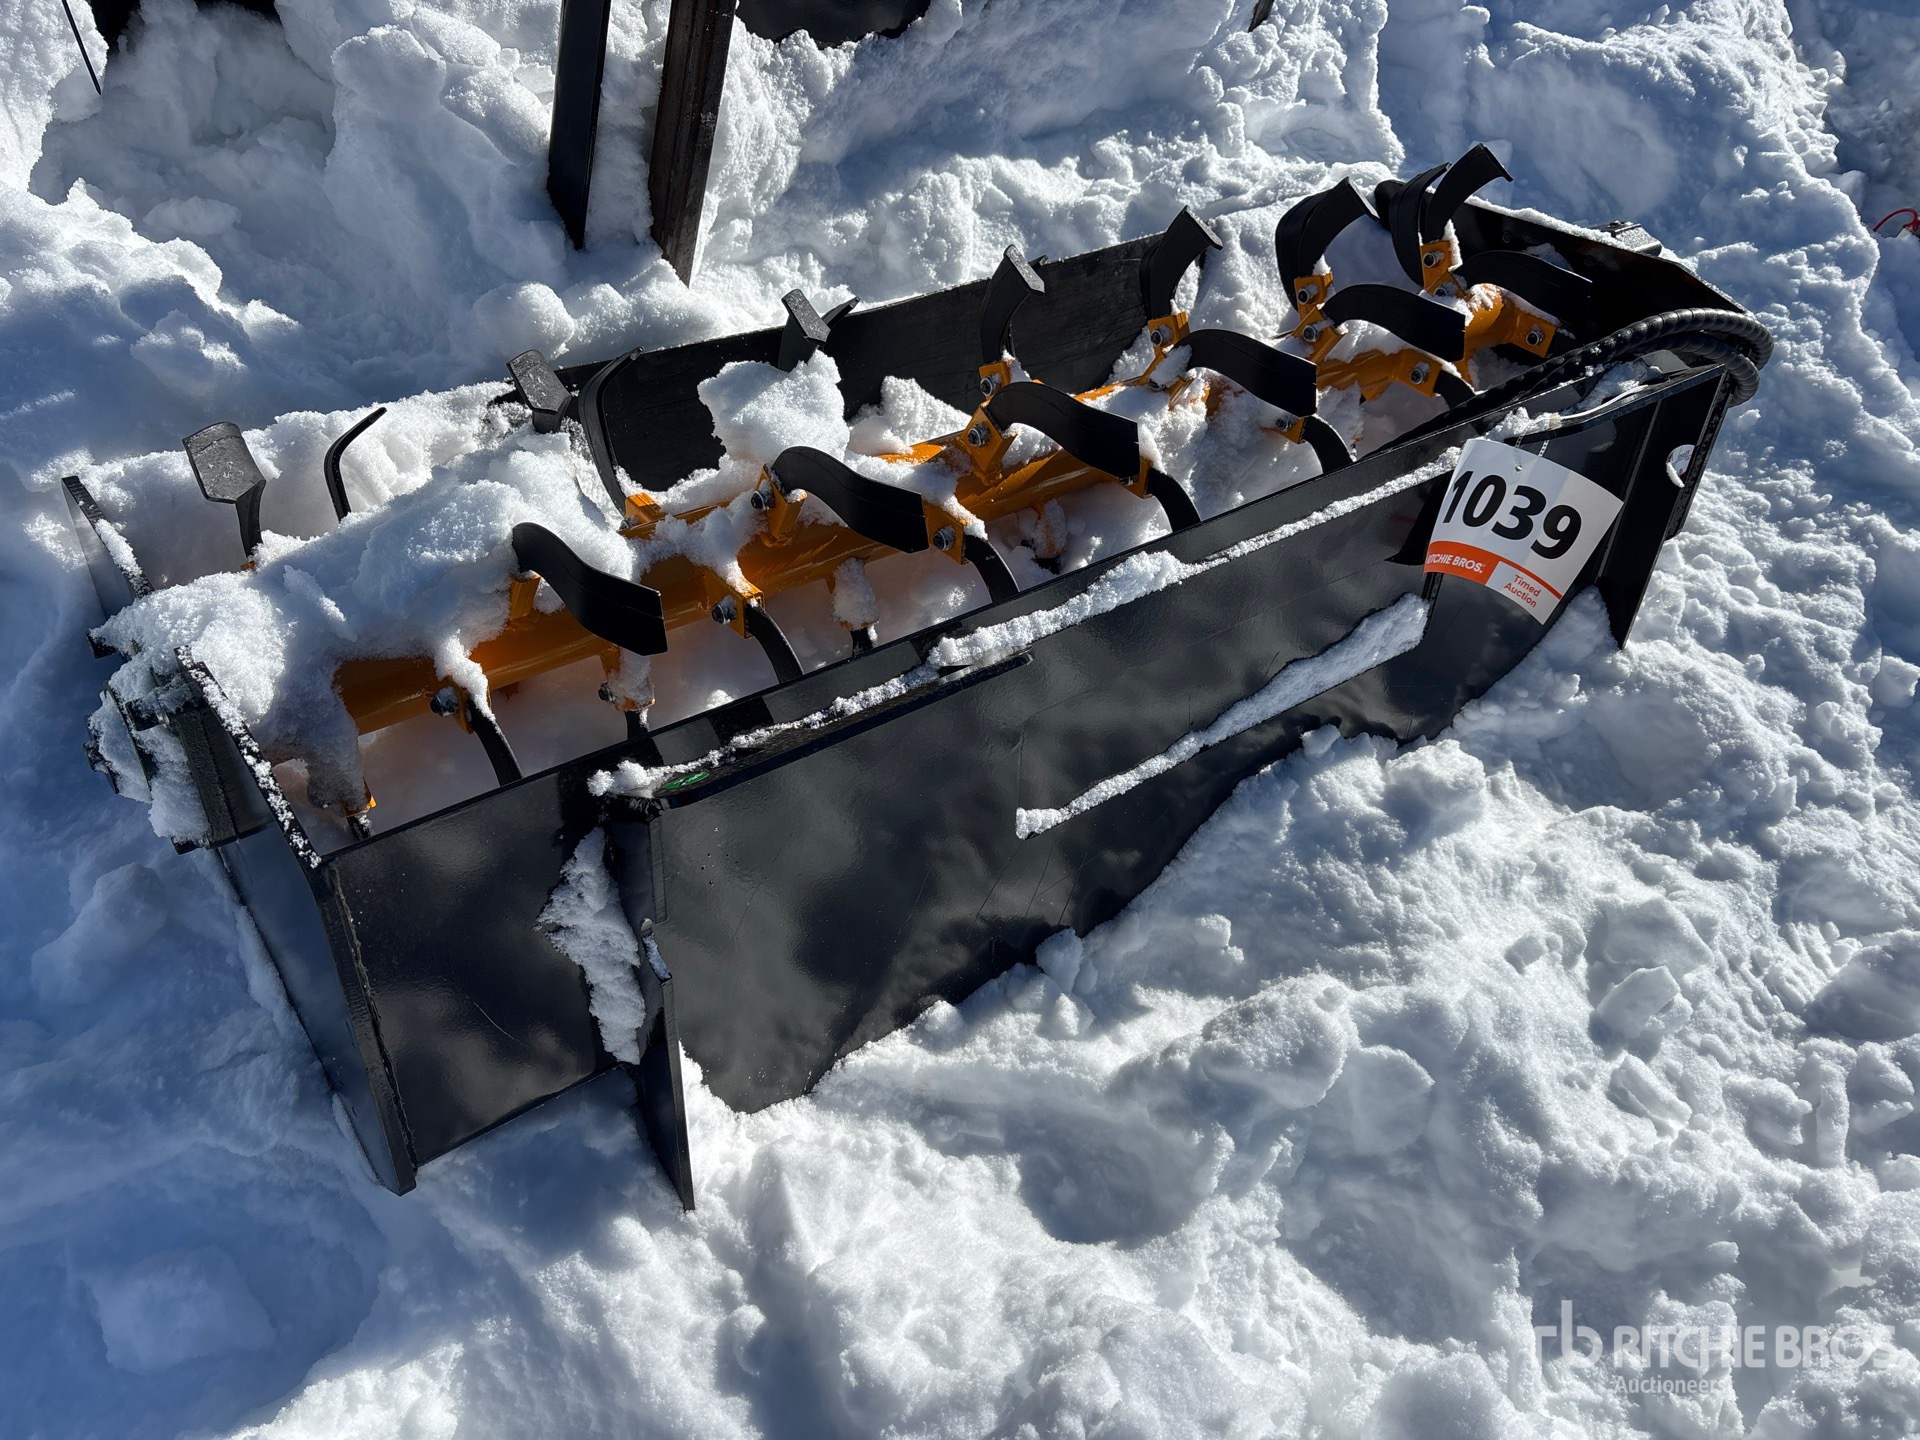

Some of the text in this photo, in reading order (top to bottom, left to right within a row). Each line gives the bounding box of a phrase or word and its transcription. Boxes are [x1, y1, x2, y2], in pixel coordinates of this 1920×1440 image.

[1443, 471, 1581, 559] 1039
[1504, 583, 1537, 608] Auction
[1514, 575, 1542, 597] Timed
